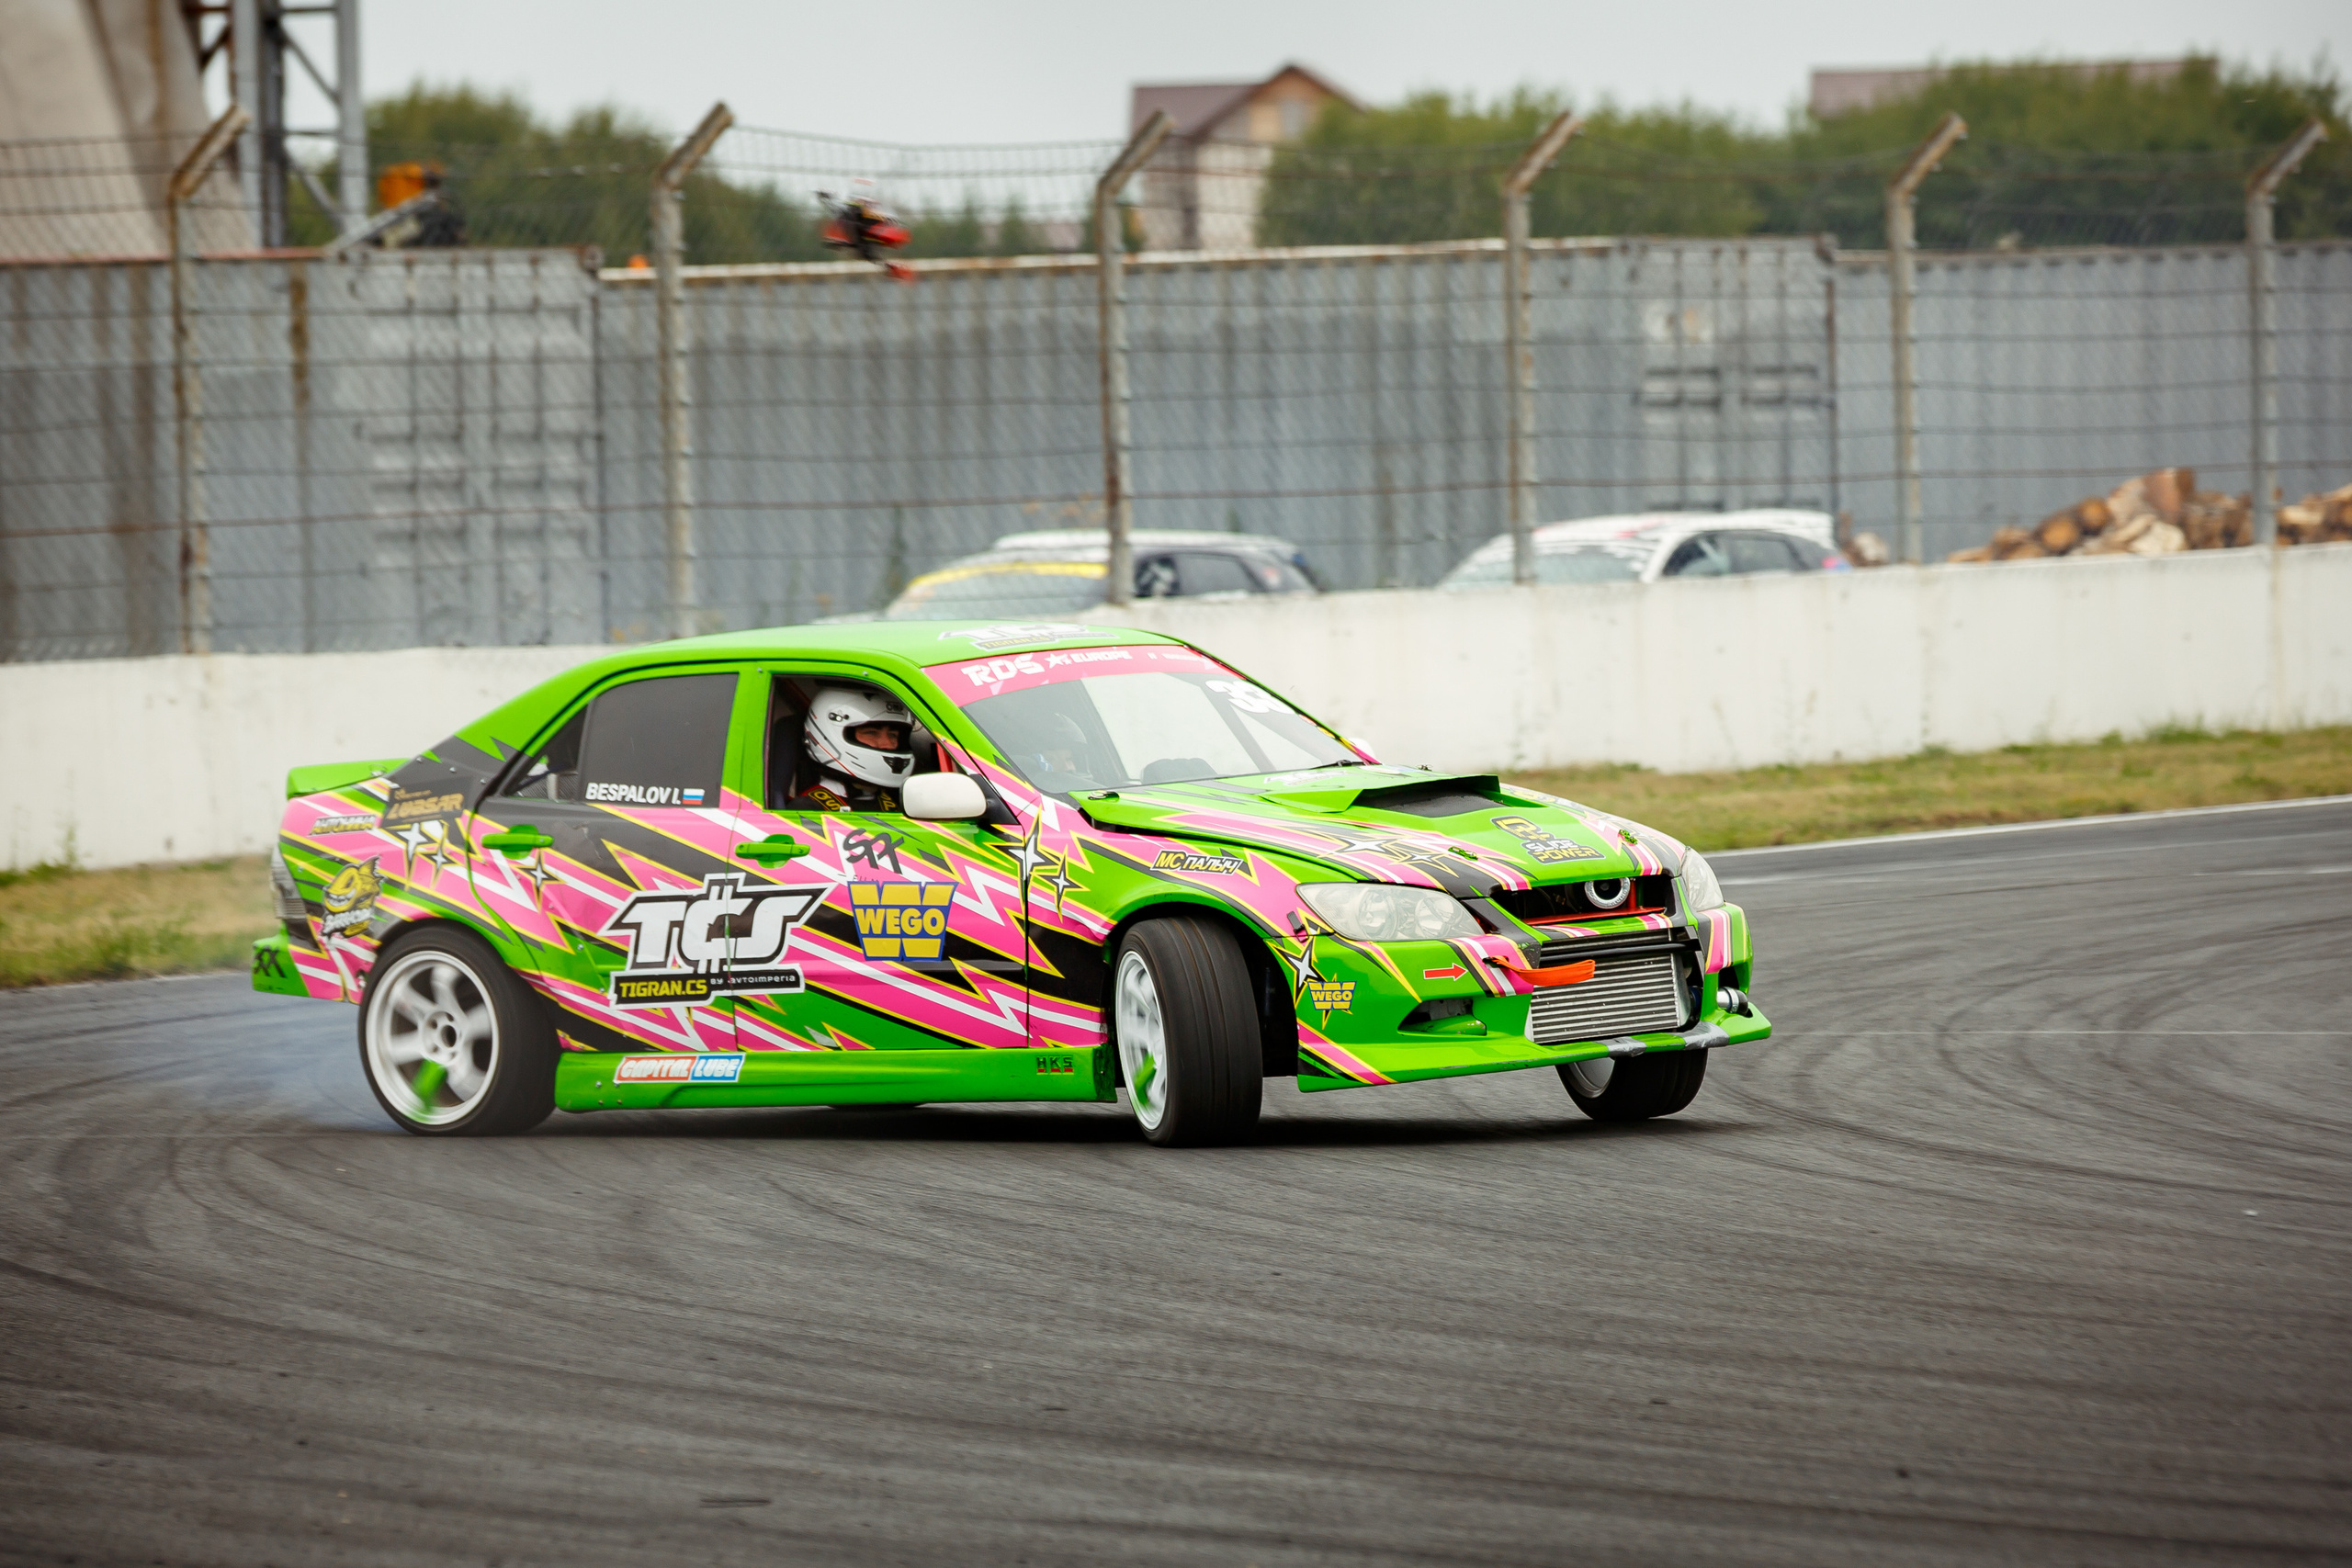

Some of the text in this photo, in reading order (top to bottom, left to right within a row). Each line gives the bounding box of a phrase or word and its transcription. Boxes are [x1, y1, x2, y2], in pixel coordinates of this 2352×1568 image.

[961, 653, 1045, 686] RDS
[1069, 650, 1133, 663] EUROPE
[585, 783, 681, 805] BESPALOV I.
[813, 791, 841, 811] QS
[1532, 847, 1600, 862] POWER
[854, 908, 945, 936] WEGO
[619, 979, 708, 998] TIGRAN.CS
[1310, 990, 1352, 1001] WEGO
[619, 1058, 741, 1078] CAPITAL LUBE
[1036, 1056, 1074, 1073] HKS
